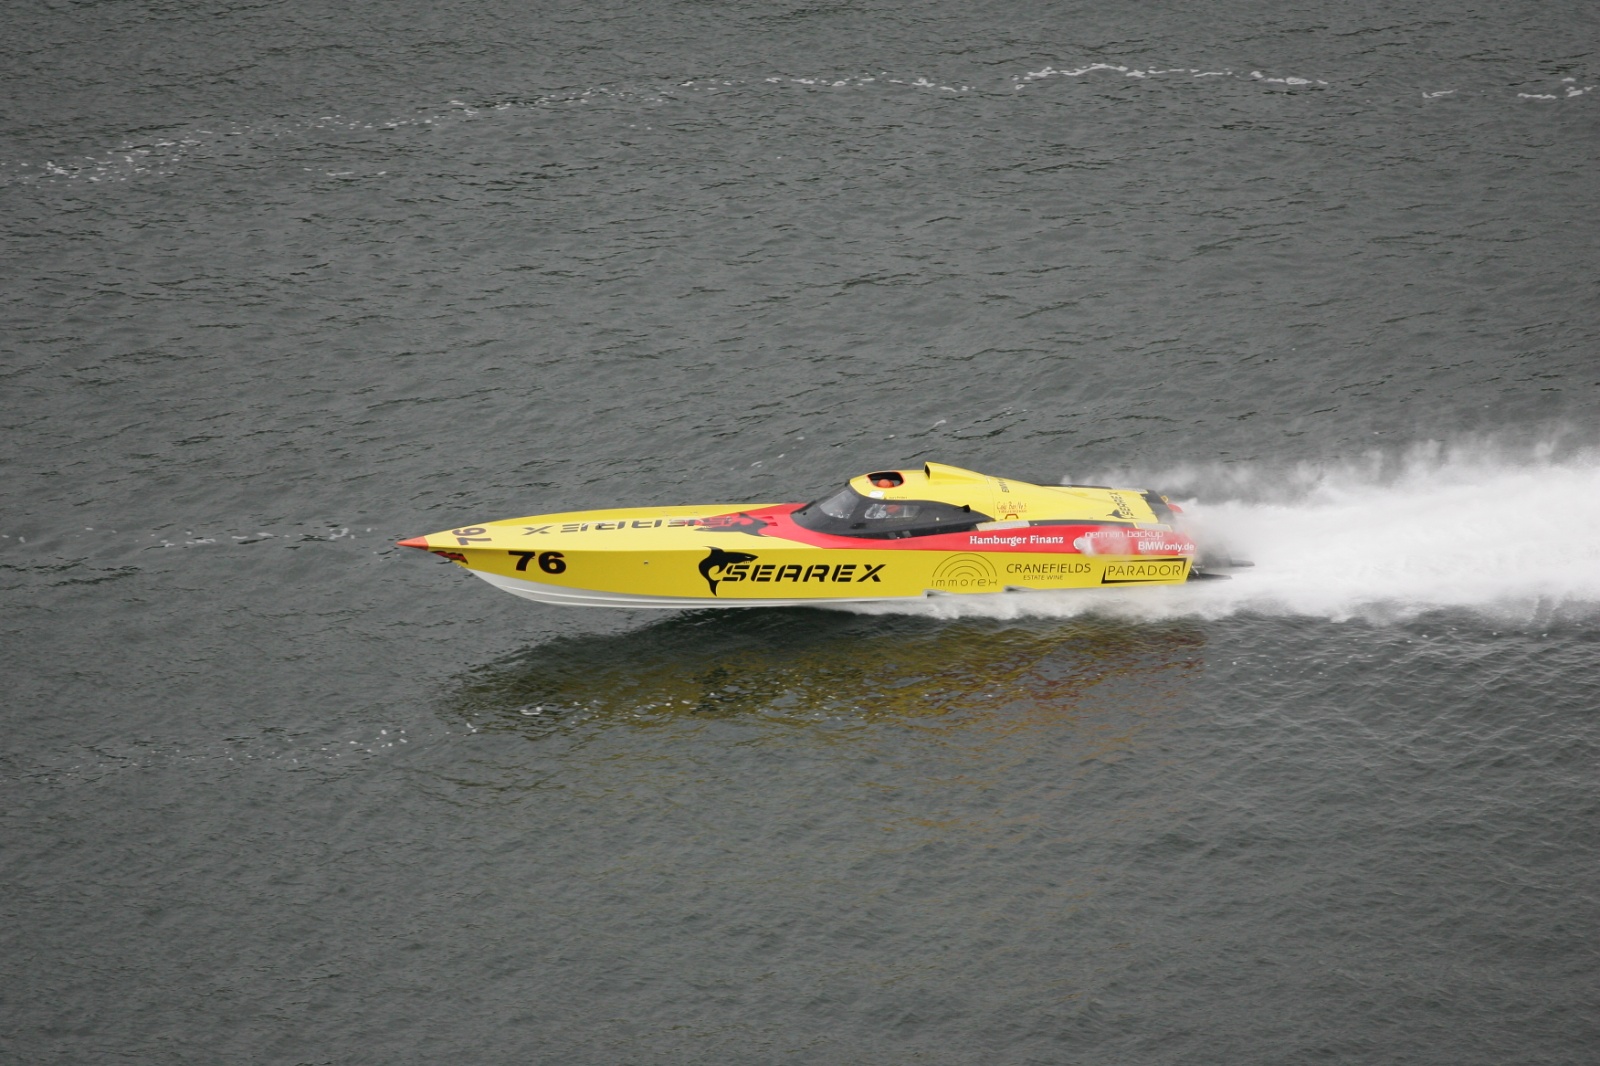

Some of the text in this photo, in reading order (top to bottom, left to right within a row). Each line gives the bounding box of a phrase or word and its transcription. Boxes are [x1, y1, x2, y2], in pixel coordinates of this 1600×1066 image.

[452, 527, 492, 546] 76
[969, 535, 1064, 547] Hamburger Finanz
[1127, 530, 1163, 541] backup
[1138, 541, 1195, 552] BMWonly.de
[508, 550, 567, 575] 76
[1006, 563, 1091, 574] CRANEFIELDS
[722, 564, 886, 583] SEAREX
[1107, 564, 1181, 576] PARADOR
